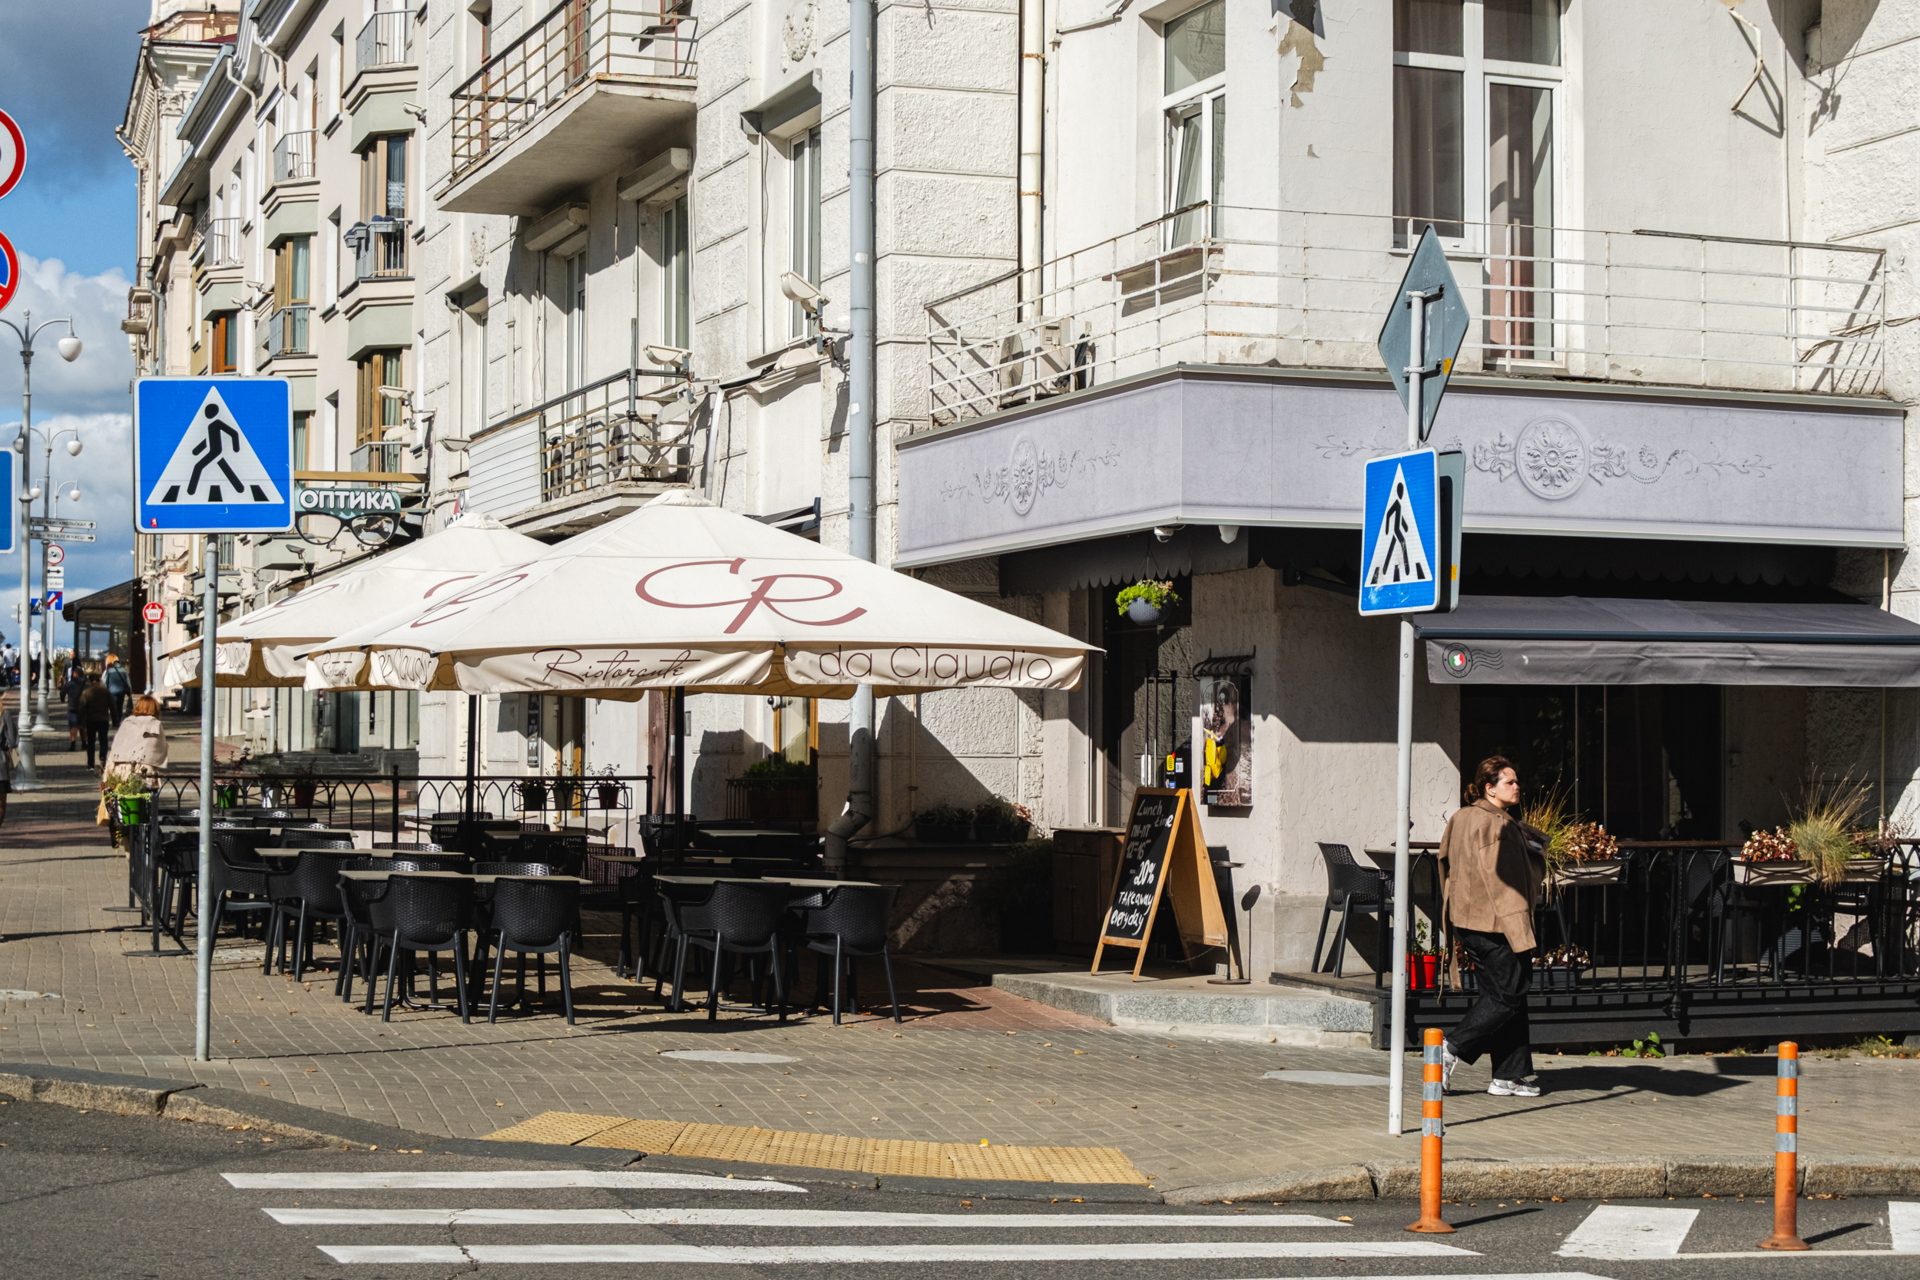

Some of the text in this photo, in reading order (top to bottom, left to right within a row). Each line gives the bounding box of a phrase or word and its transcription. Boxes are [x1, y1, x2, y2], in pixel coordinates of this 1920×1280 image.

[299, 489, 396, 511] ОПТИКА
[532, 647, 702, 683] Ristorante
[819, 644, 1053, 682] da Claudio
[1136, 799, 1163, 816] Lunch
[1154, 814, 1174, 827] time
[1110, 908, 1145, 936] everyday
